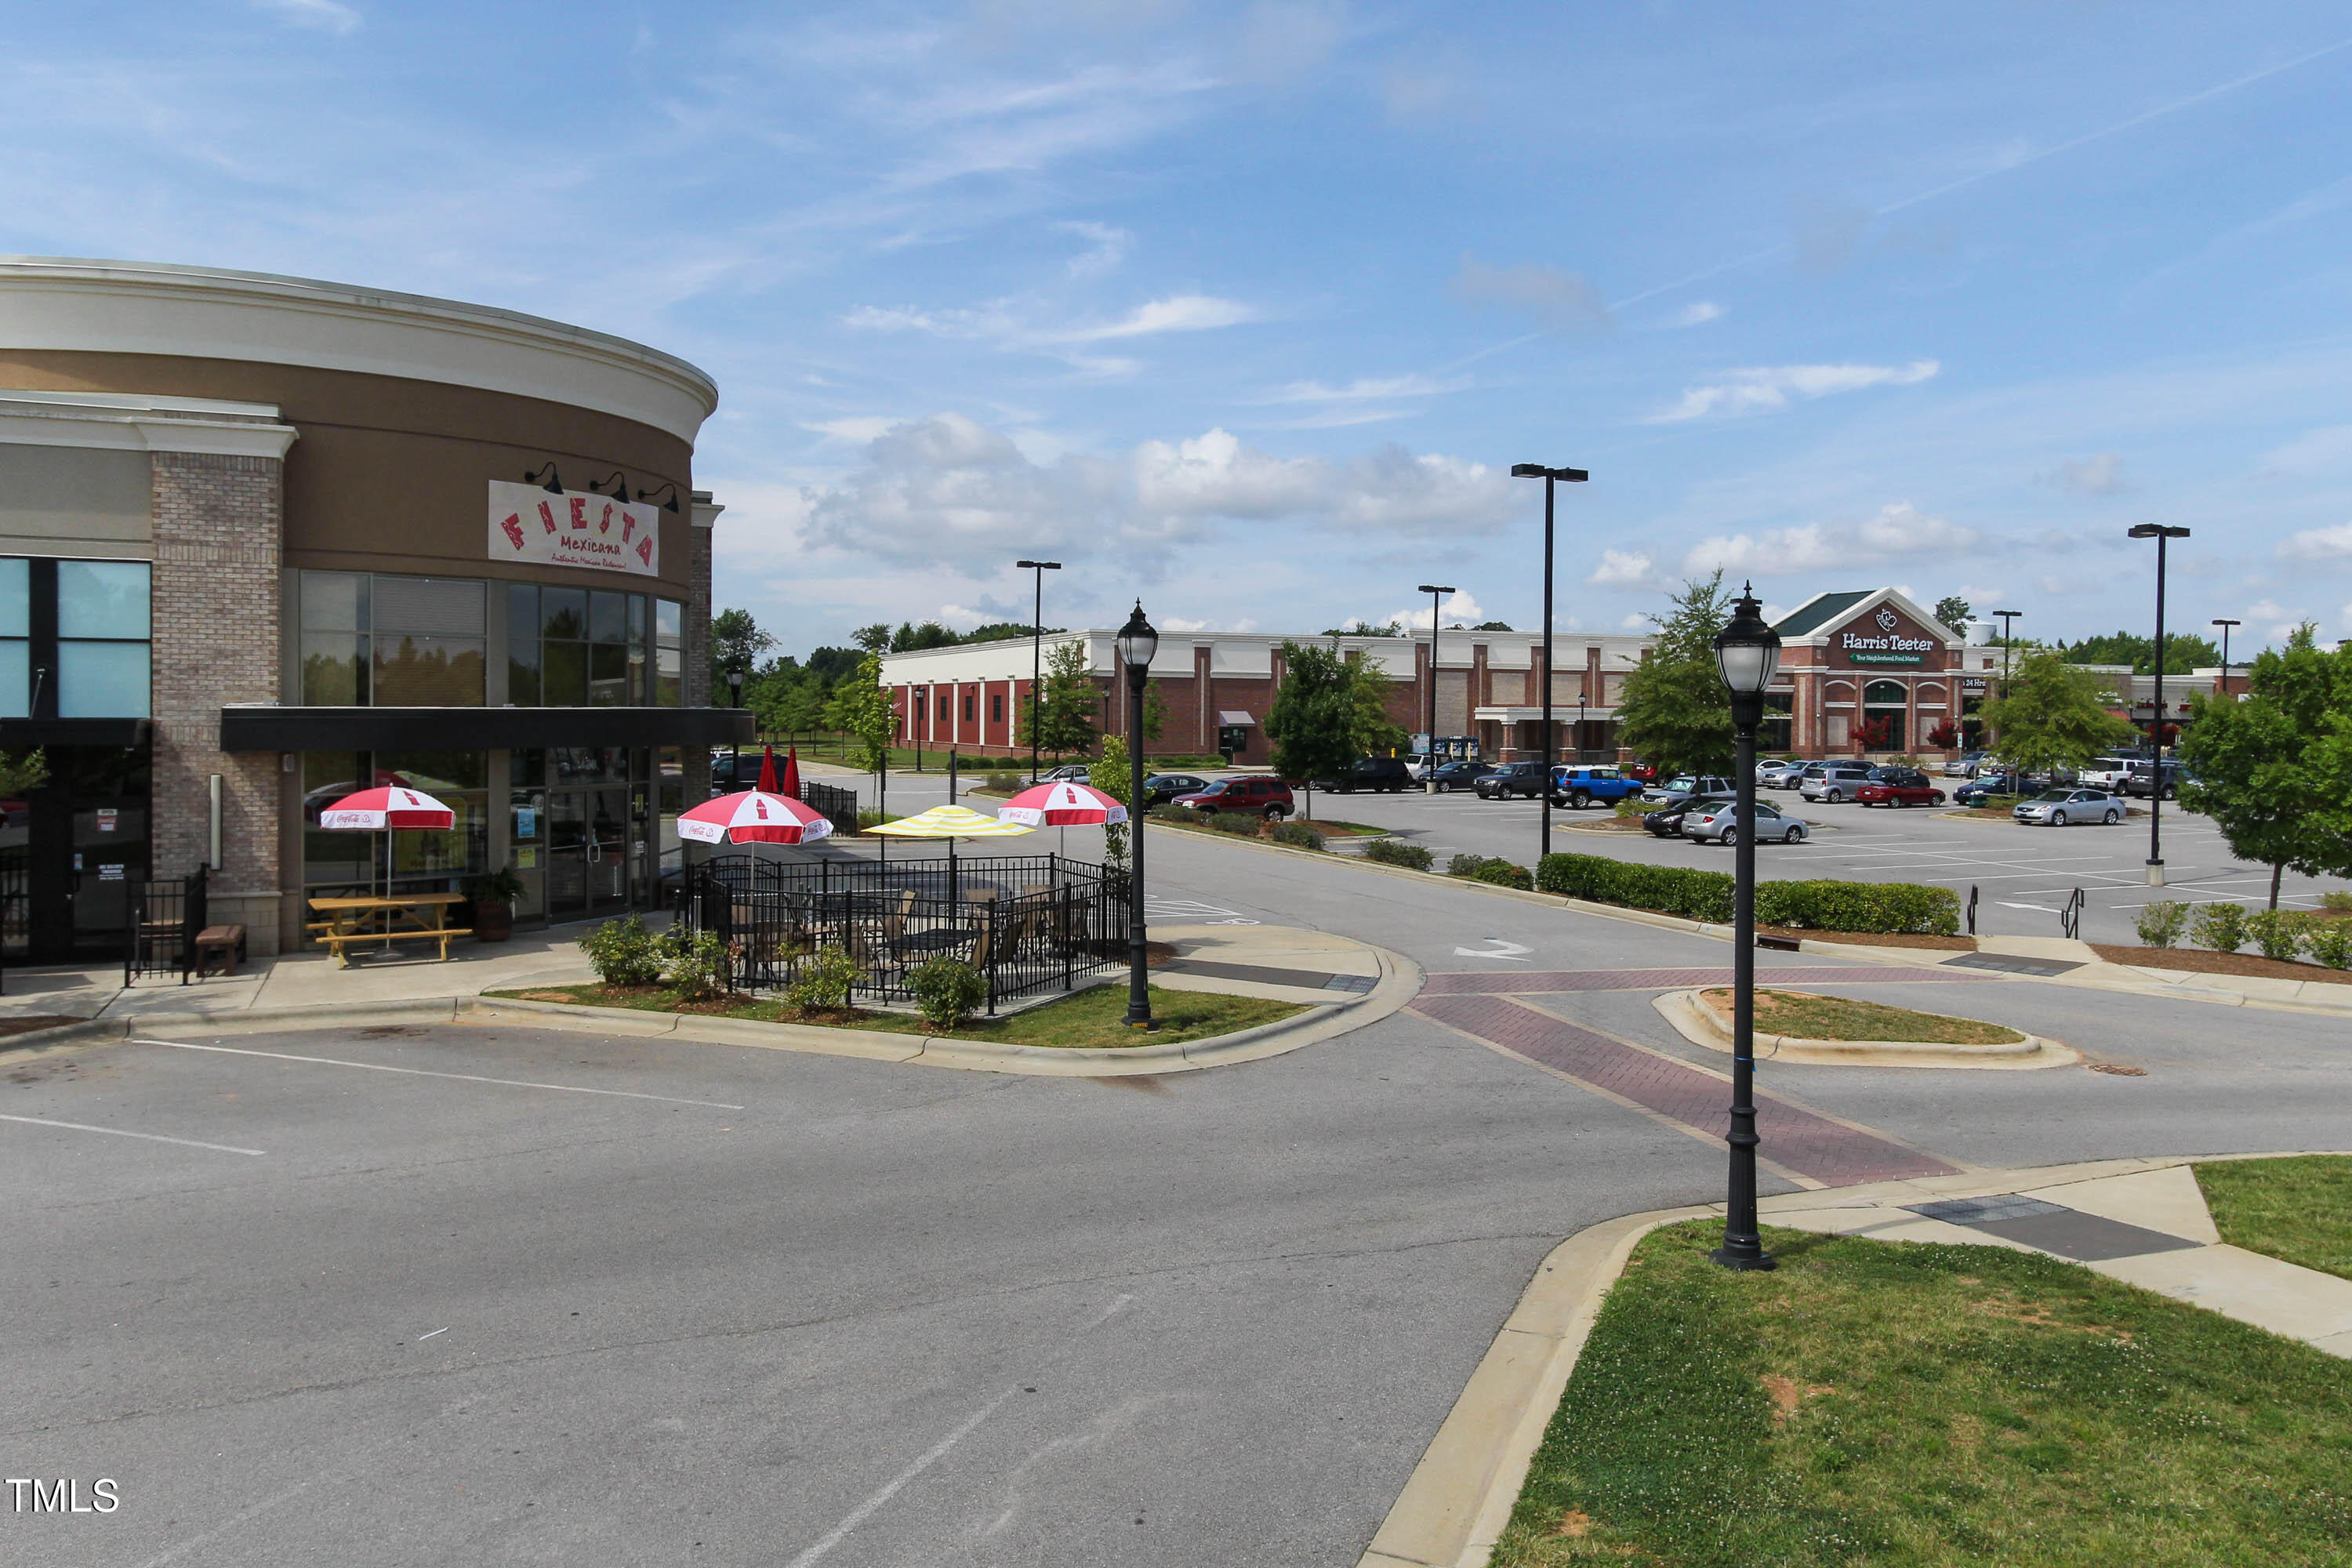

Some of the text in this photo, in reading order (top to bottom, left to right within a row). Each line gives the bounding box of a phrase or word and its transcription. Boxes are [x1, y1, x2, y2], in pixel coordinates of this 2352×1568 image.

[501, 498, 652, 568] FIESTA
[561, 535, 621, 555] Mexicana
[552, 553, 627, 569] Authentic Mexican Restaurant
[1842, 633, 1933, 651] Harris Teeter
